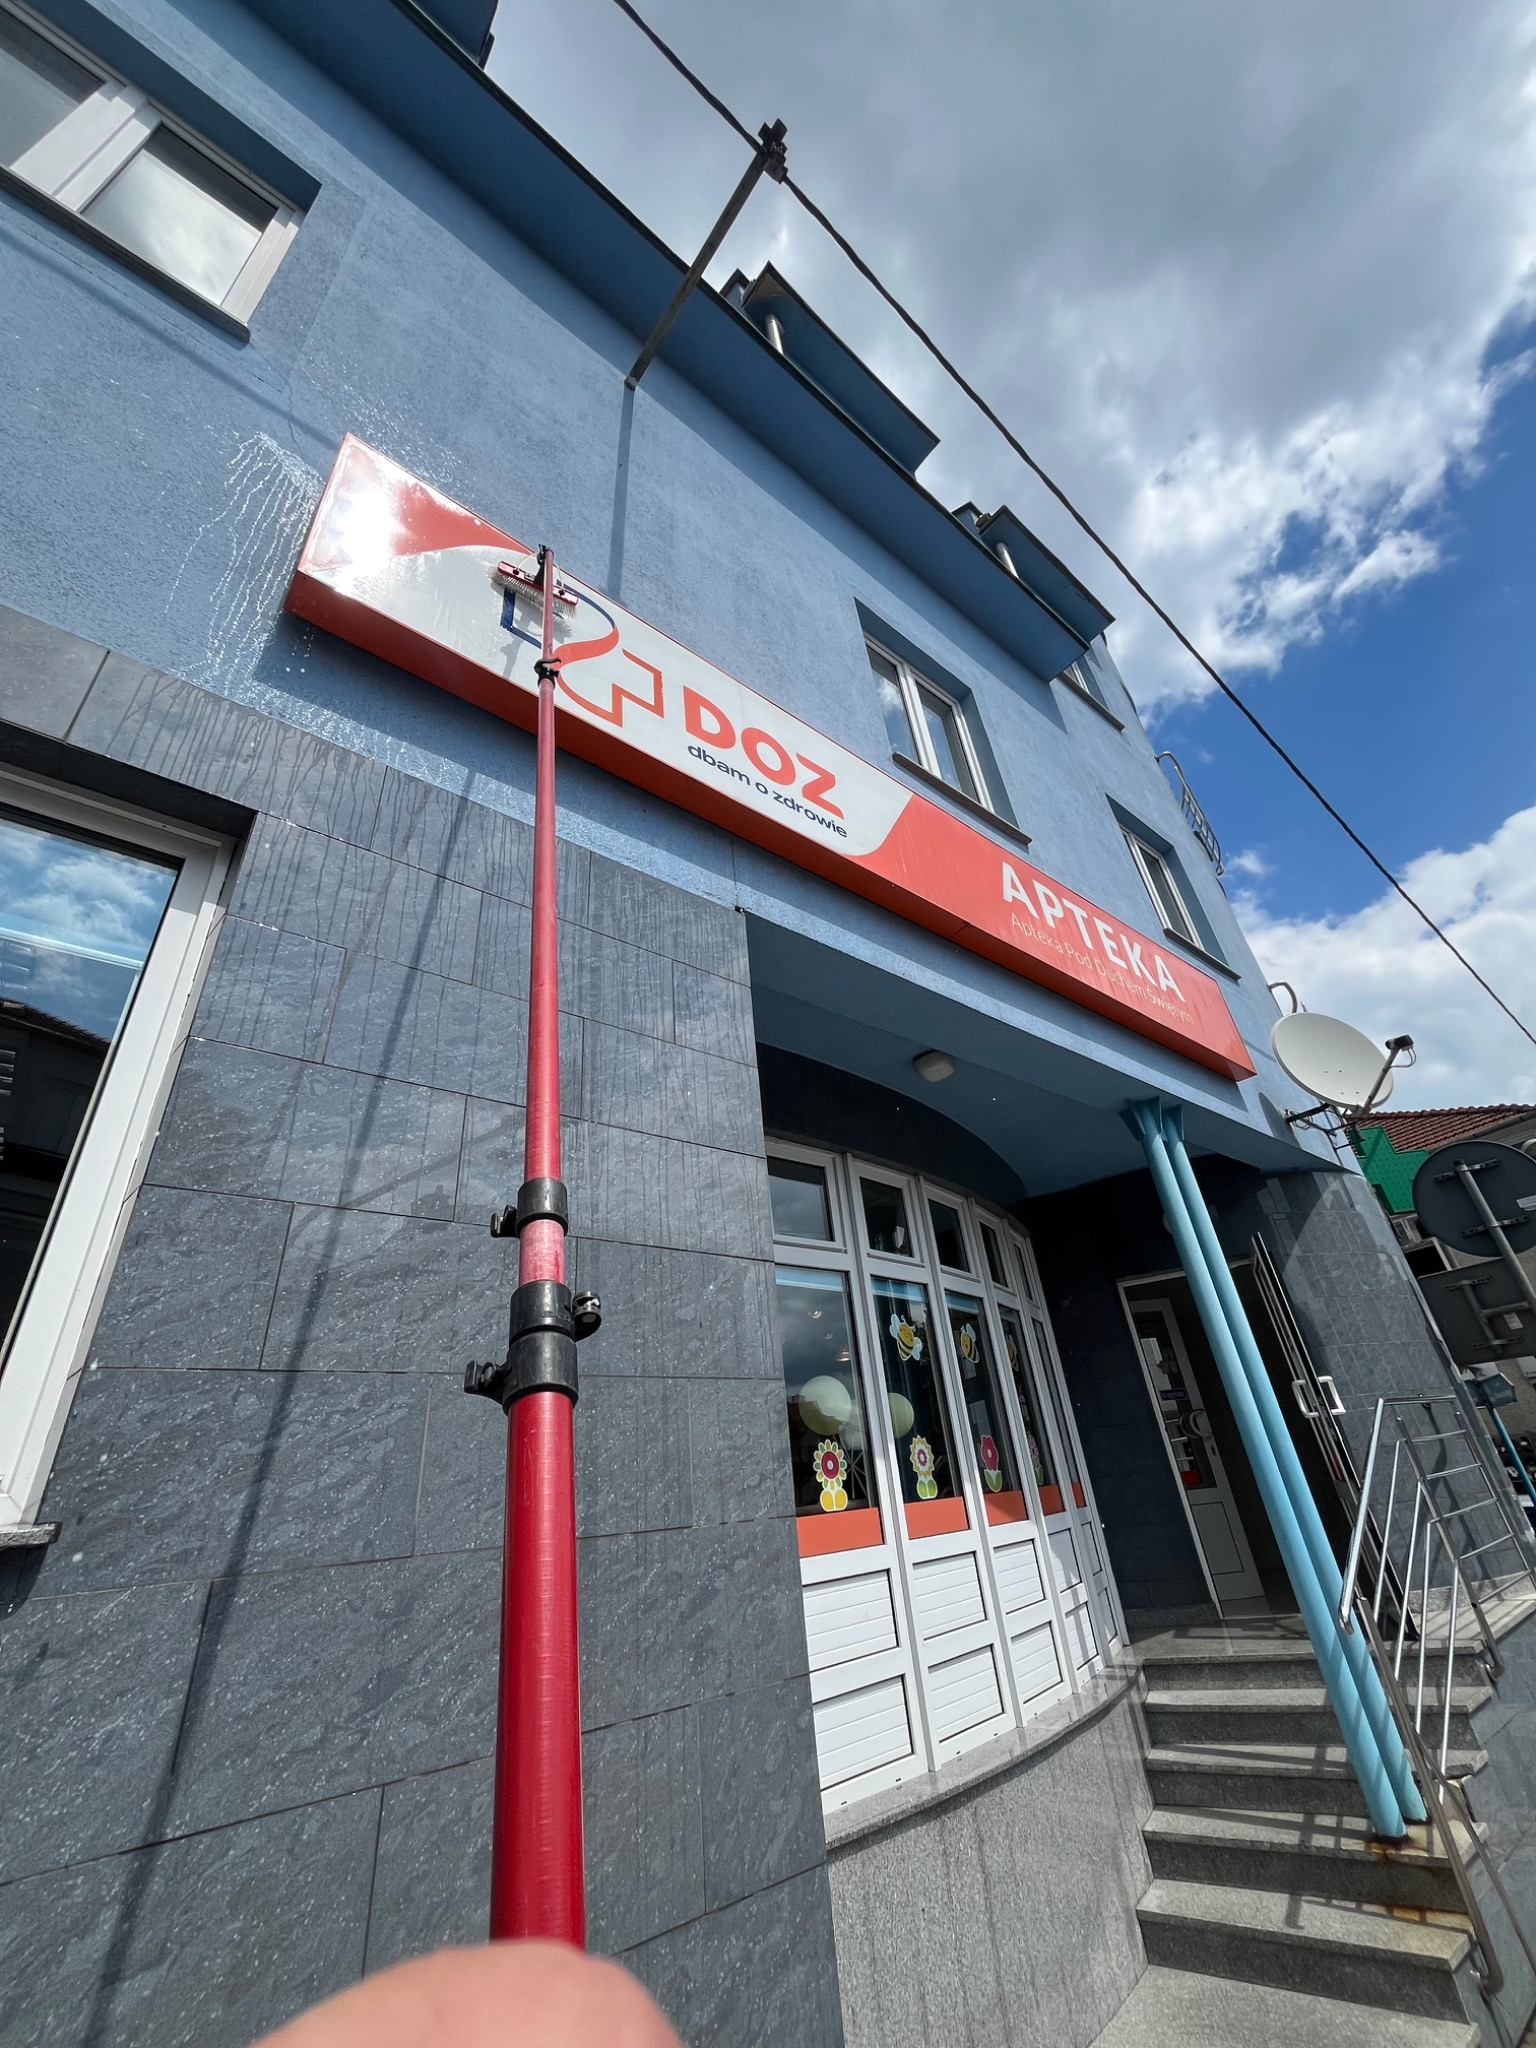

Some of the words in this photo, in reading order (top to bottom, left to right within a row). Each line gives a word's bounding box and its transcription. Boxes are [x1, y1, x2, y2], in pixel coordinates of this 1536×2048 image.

[683, 685, 844, 820] DOZ
[687, 745, 751, 786] dbam
[755, 781, 769, 795] o
[772, 790, 848, 838] zdrowie
[1002, 861, 1187, 1002] APTEKA
[1012, 914, 1063, 952] Apteka
[1065, 944, 1093, 969] Pod
[1095, 960, 1146, 994] Duchem
